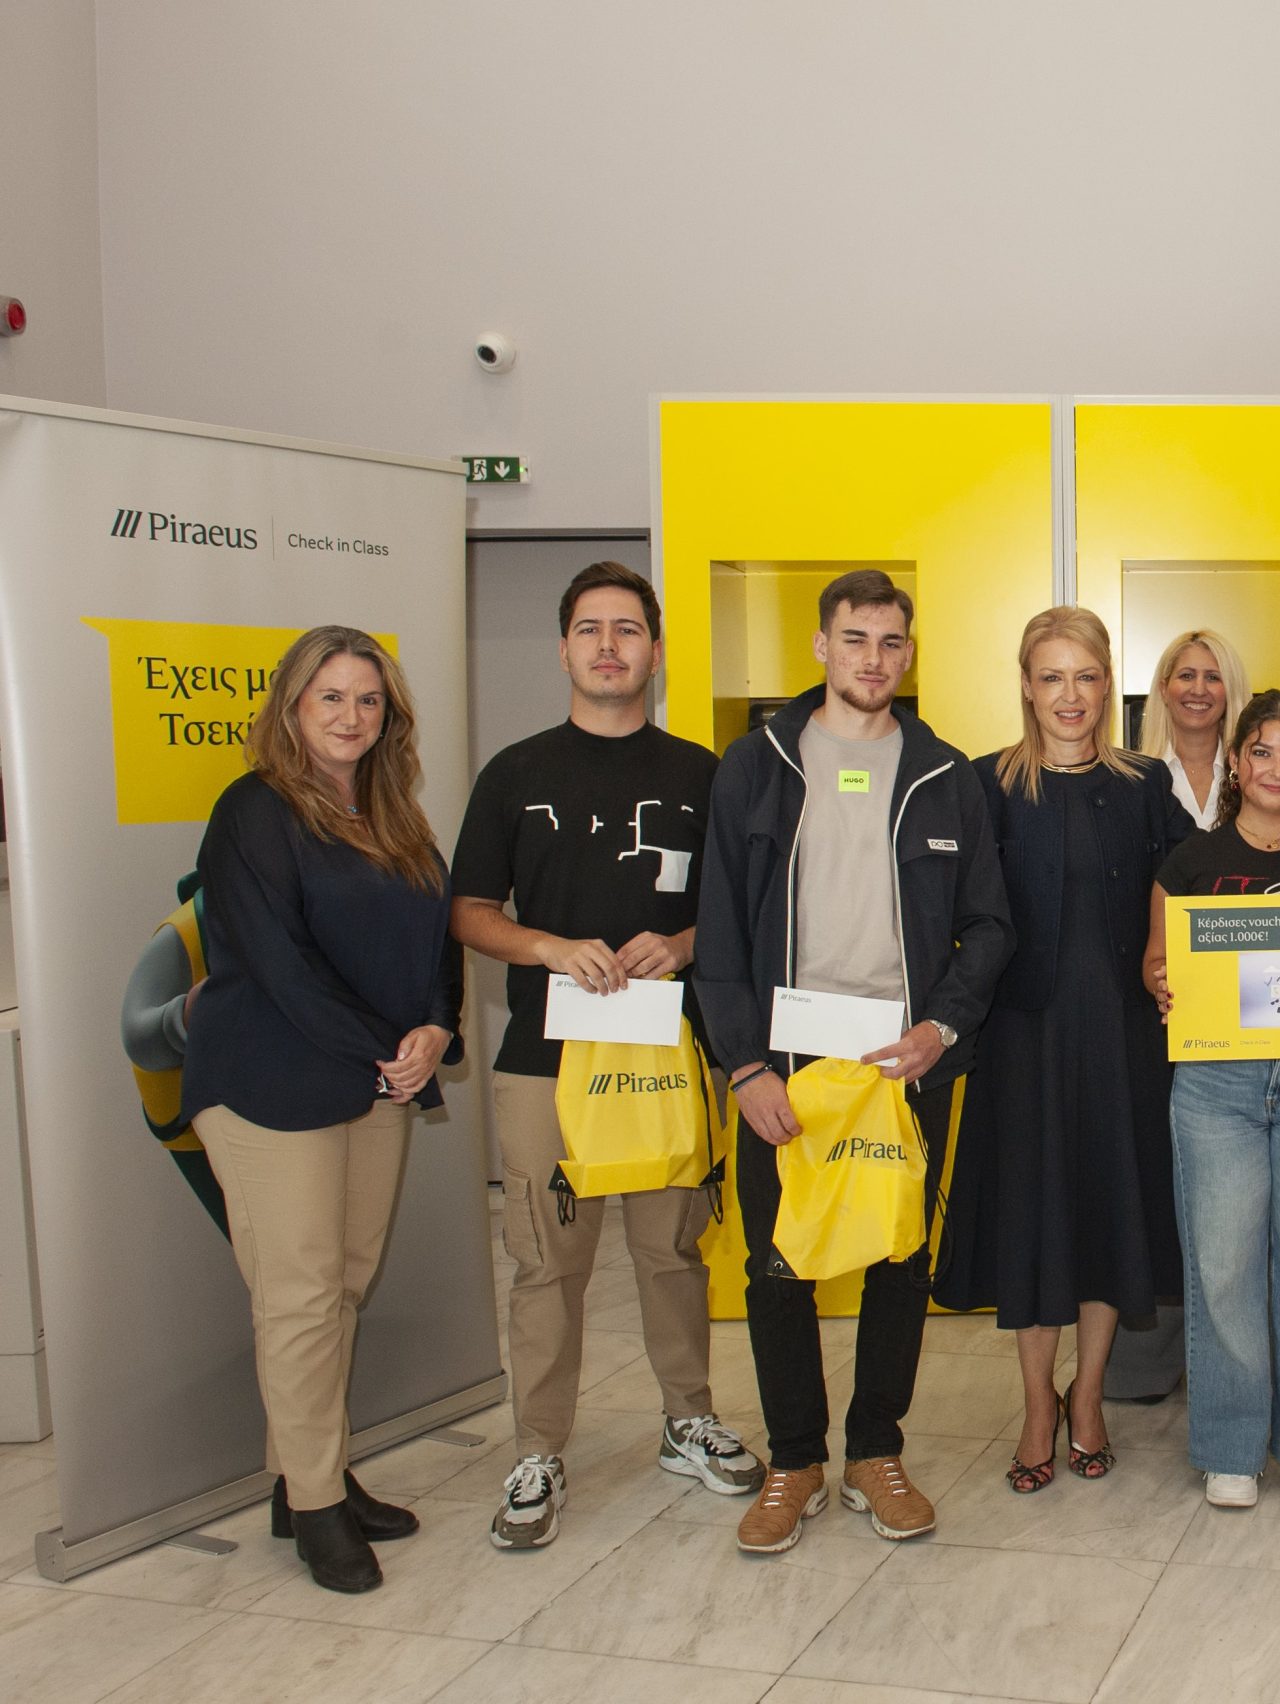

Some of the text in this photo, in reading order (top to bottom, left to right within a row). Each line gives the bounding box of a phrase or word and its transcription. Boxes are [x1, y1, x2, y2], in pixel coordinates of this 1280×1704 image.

[148, 511, 258, 550] Piraeus
[288, 533, 389, 557] Check in Class
[137, 656, 237, 700] Έχεις
[1198, 917, 1247, 930] Κέρδισες
[1198, 931, 1269, 944] αξίας 1.000€!
[1194, 1039, 1231, 1049] Piraeus
[616, 1072, 688, 1094] Piraeus
[849, 1137, 908, 1161] Piraeu
